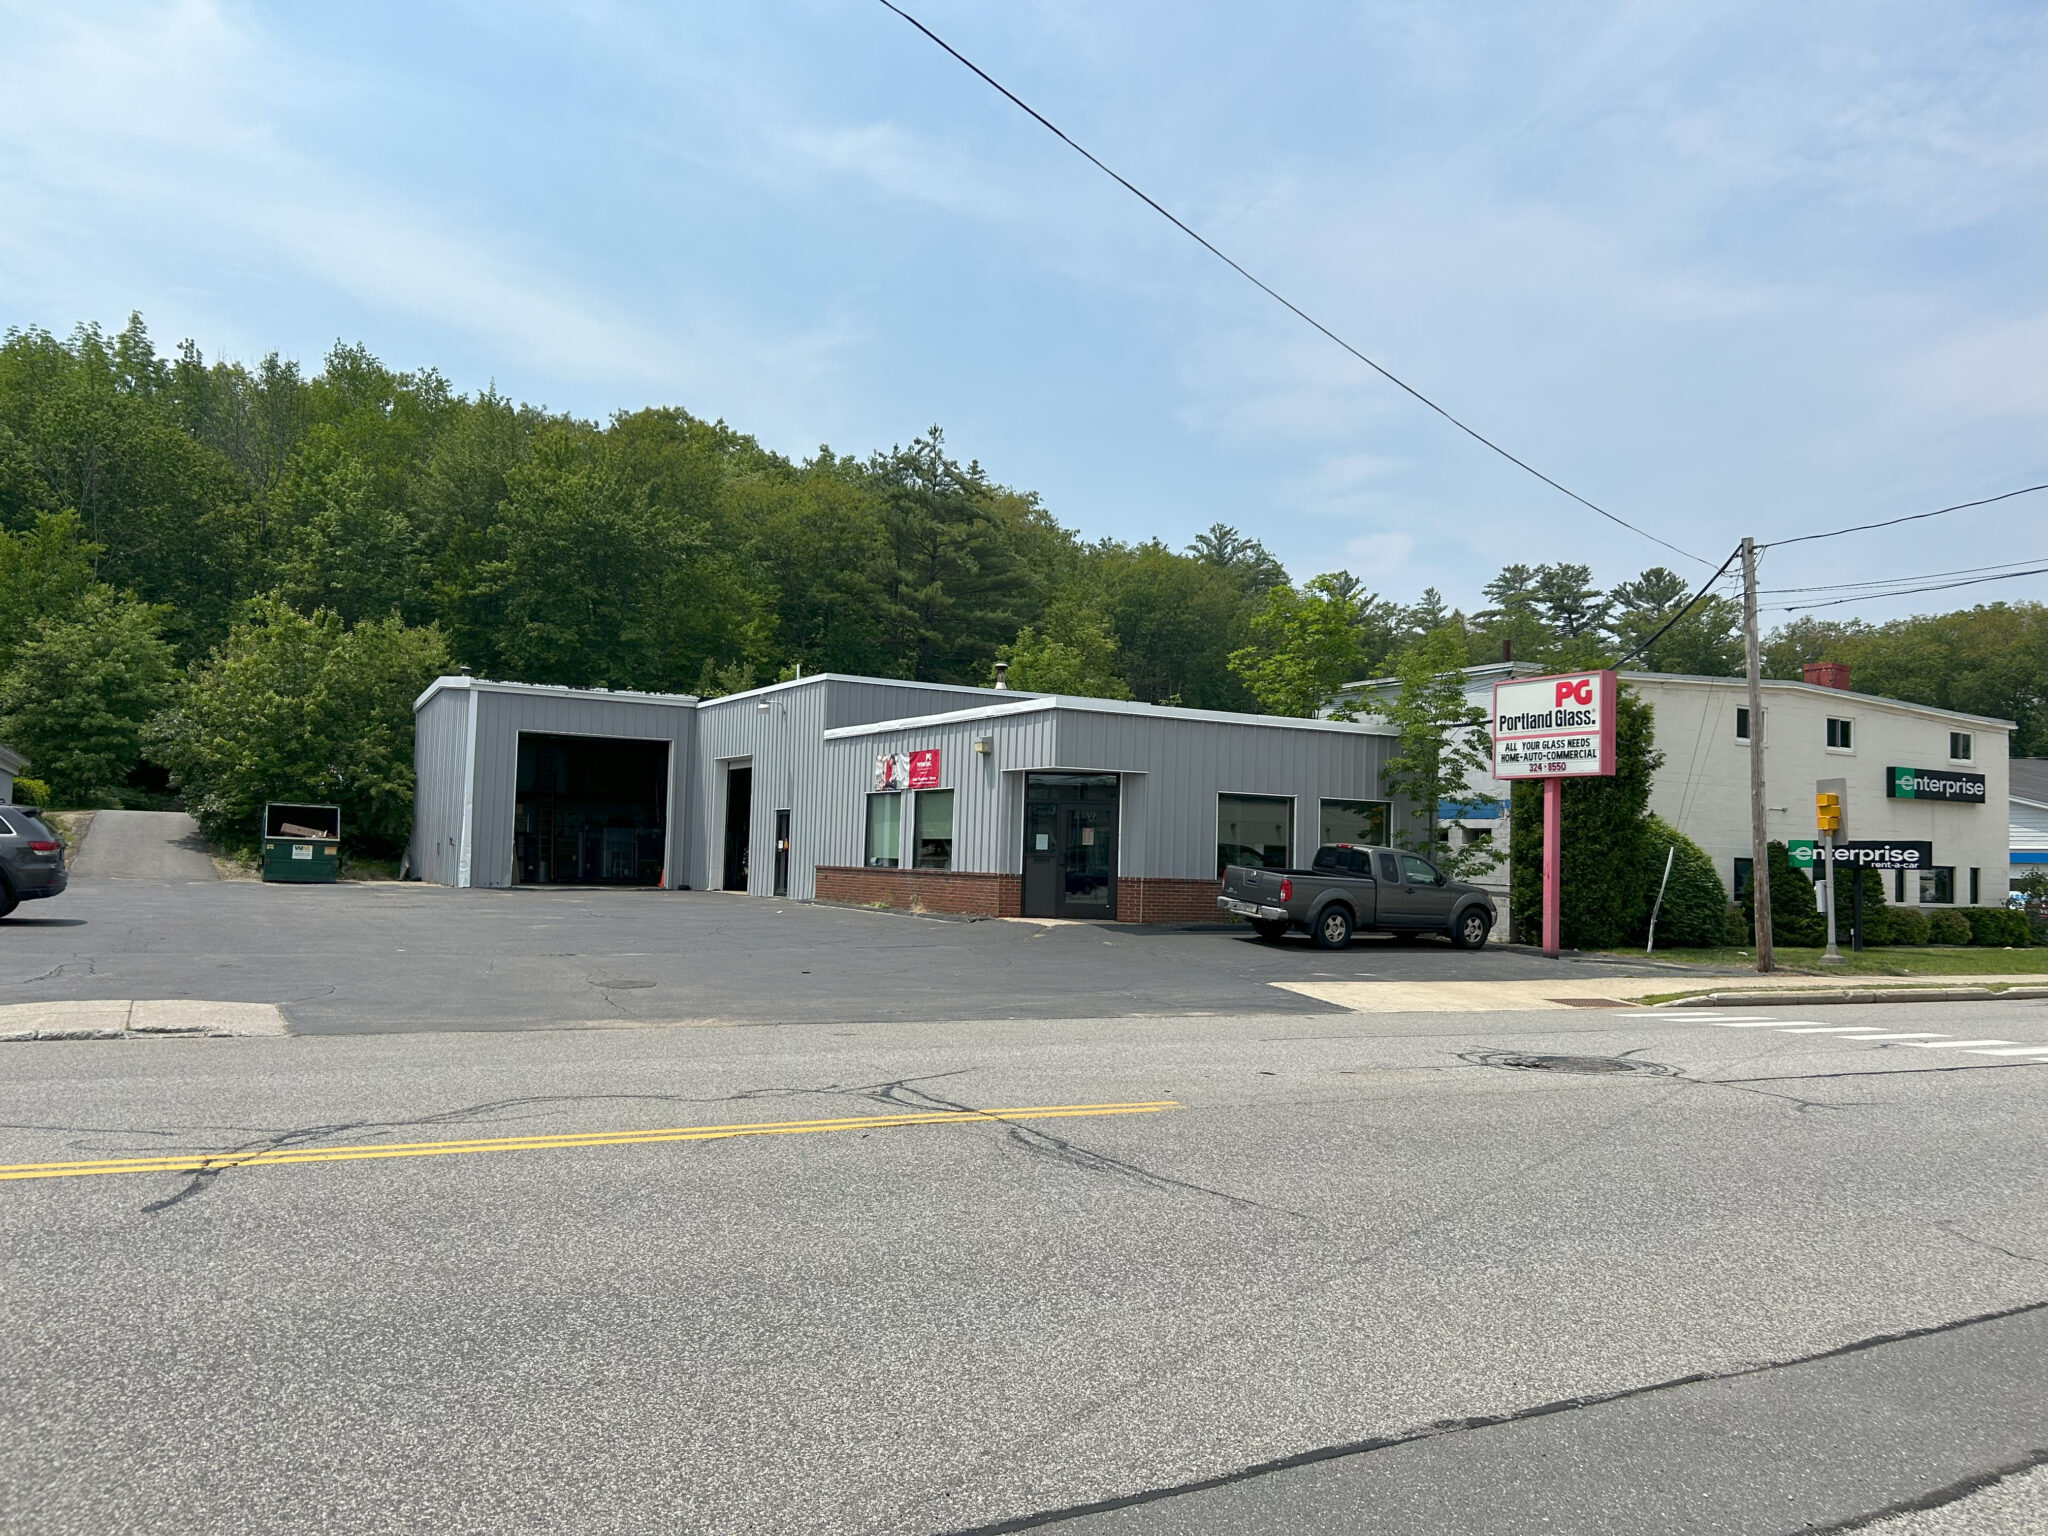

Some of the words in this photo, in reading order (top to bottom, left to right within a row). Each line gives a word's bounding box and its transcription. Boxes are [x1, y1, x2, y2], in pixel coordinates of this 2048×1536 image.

[1555, 679, 1593, 708] PG
[1499, 710, 1552, 732] Portland
[1504, 742, 1518, 752] ALL
[1522, 741, 1540, 751] YOUR
[1542, 739, 1566, 750] GLASS
[1567, 738, 1590, 748] NEEDS
[1895, 775, 1985, 797] enterprise
[1871, 861, 1920, 869] rent-a-car
